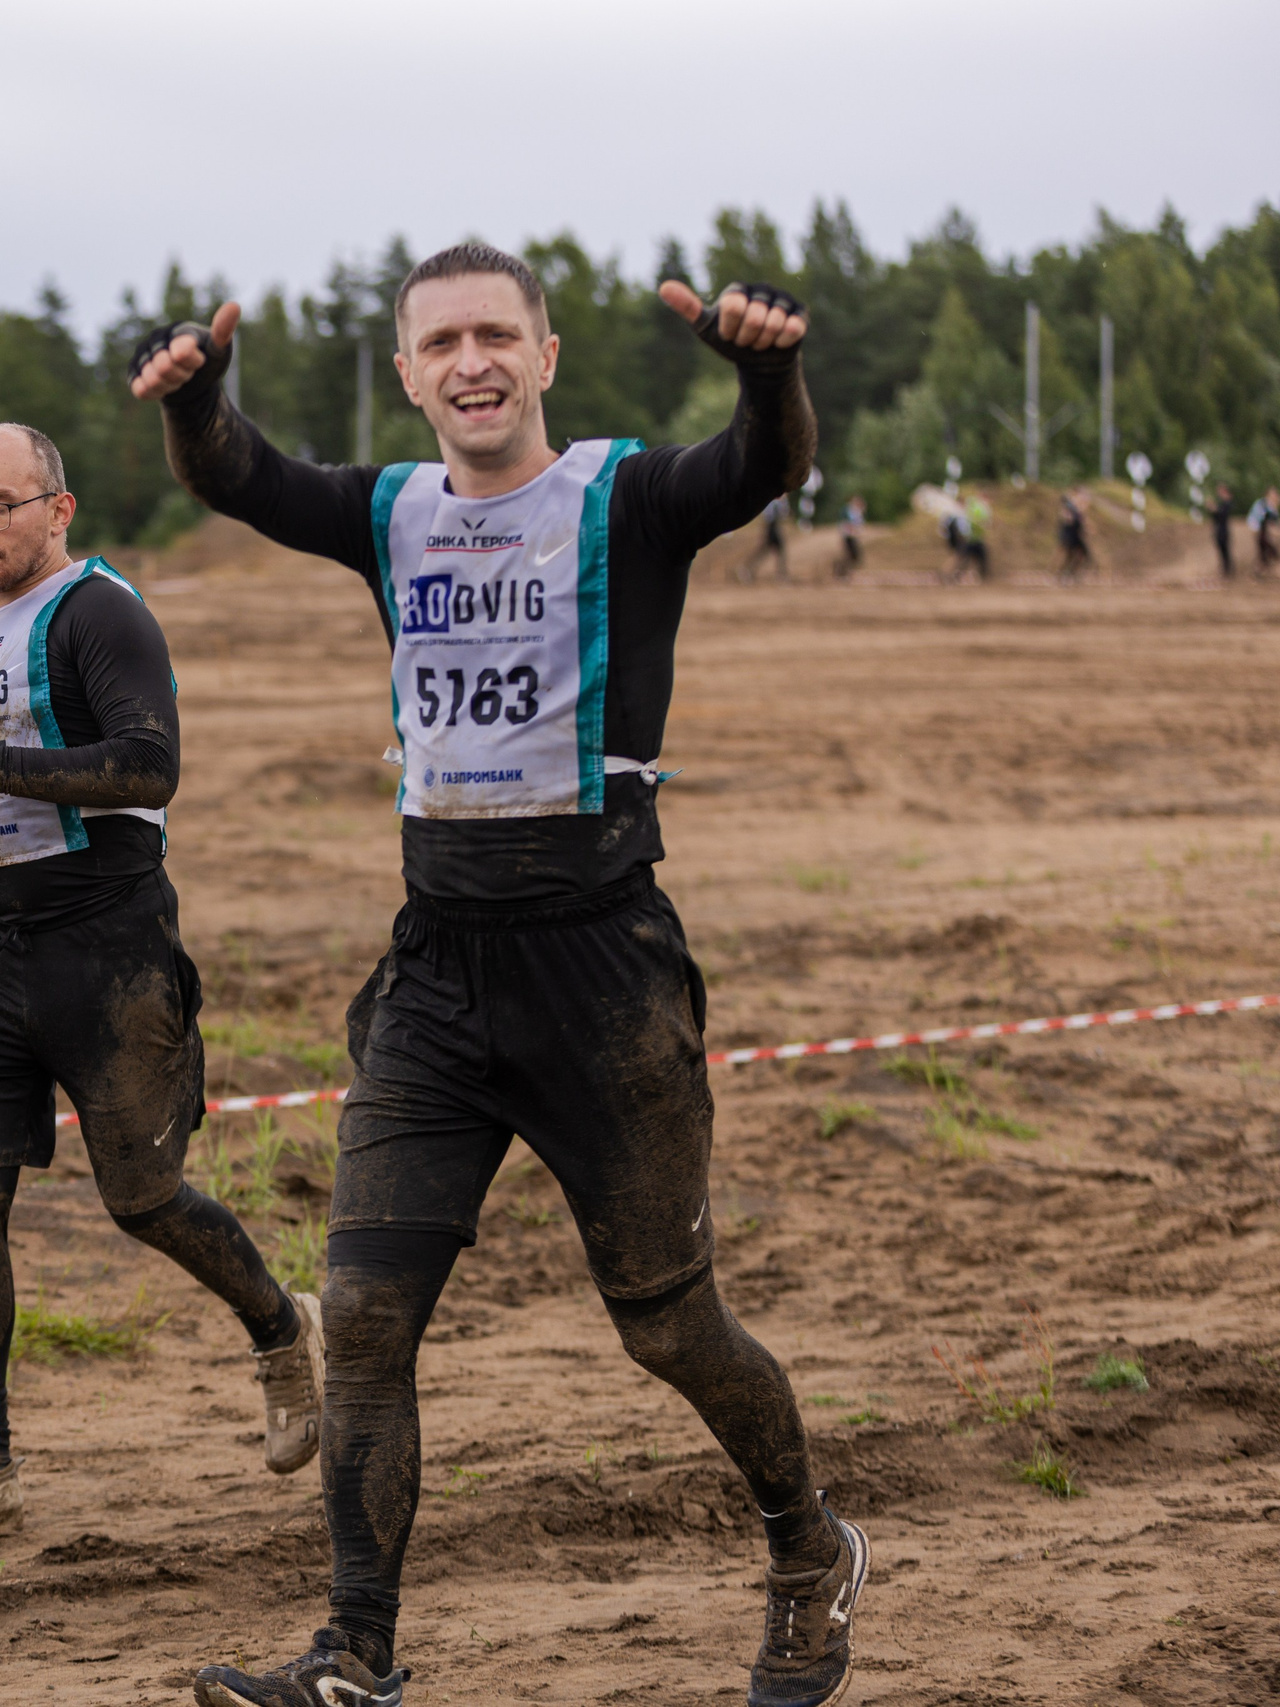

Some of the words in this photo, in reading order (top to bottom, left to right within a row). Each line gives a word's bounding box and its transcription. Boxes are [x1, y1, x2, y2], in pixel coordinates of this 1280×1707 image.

[426, 535, 467, 548] ОНКА
[404, 578, 546, 628] RODVIG
[416, 665, 539, 728] 5163
[441, 769, 524, 785] ГАЗПРОМБАНК
